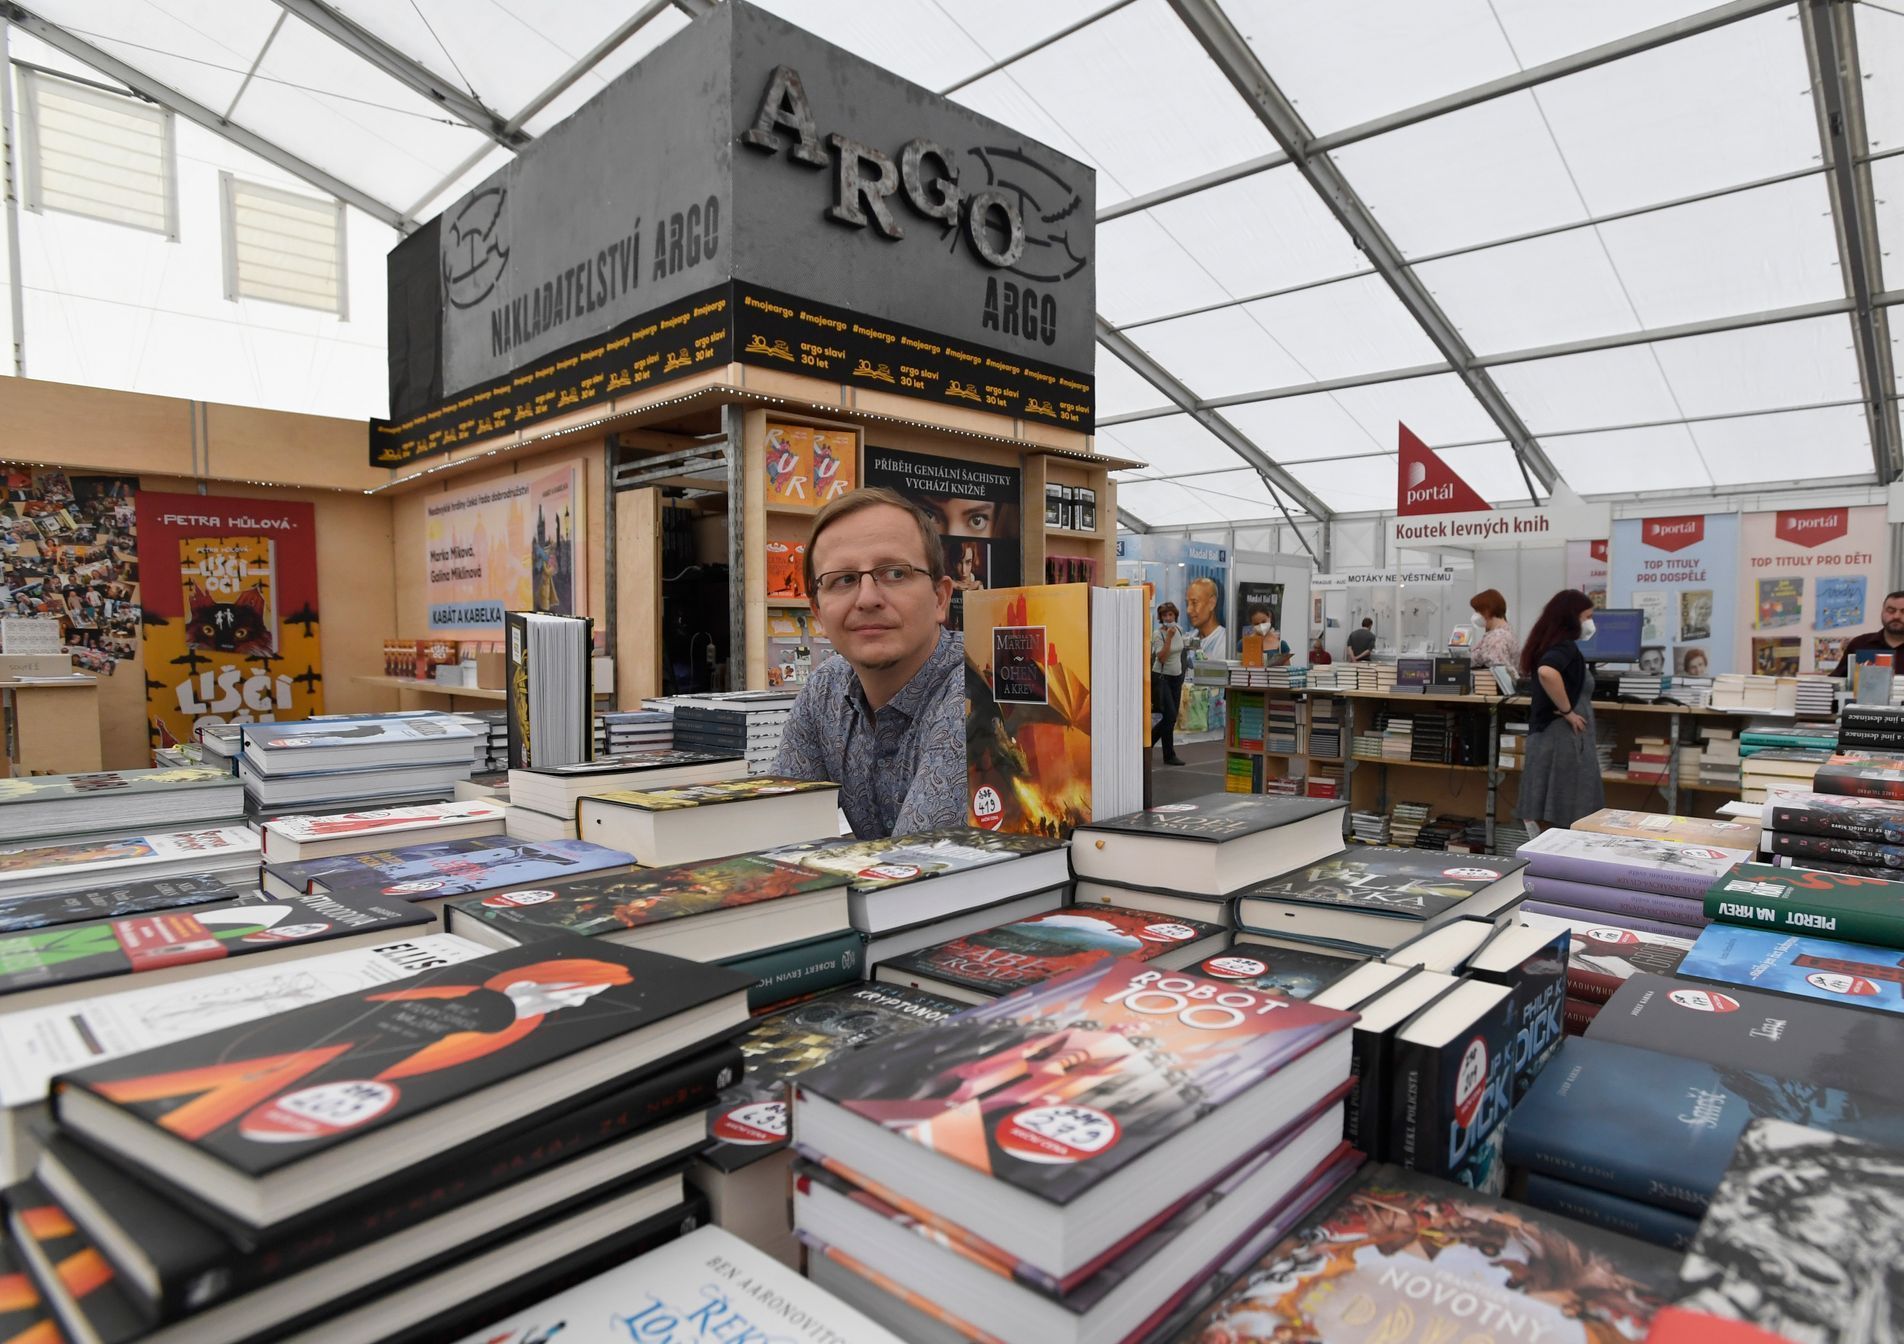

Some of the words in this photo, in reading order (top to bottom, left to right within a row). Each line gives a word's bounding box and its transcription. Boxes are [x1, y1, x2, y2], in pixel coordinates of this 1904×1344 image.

[741, 63, 1026, 269] ARGO
[490, 216, 642, 357] NAKLADATELSTVÍ
[652, 194, 721, 283] ARGO
[980, 276, 1058, 346] ARGO
[744, 296, 794, 318] #mojeargo
[799, 311, 848, 331] #mojeargo
[852, 324, 896, 343] #mojeargo
[901, 336, 941, 354] #mojeargo
[945, 347, 982, 366] #mojeargo
[800, 341, 822, 355] argo
[801, 354, 815, 365] 30
[816, 358, 829, 369] let
[900, 365, 919, 377] argo
[900, 376, 912, 387] 30
[914, 380, 924, 390] let
[985, 385, 1001, 395] argo
[985, 395, 996, 405] 30
[997, 398, 1007, 407] let
[874, 457, 912, 475] PŘÍBĚH
[914, 463, 961, 480] GENIÁLNÍ
[962, 468, 1012, 487] ŠACHISTKY
[905, 475, 950, 493] VYCHÁZÍ
[950, 481, 987, 498] KNIŽNĚ
[1406, 483, 1454, 505] portál
[164, 514, 221, 527] PETRA
[228, 515, 291, 530] HŮLOVÁ
[1396, 522, 1447, 540] Koutek
[1451, 518, 1509, 539] levných
[1514, 515, 1550, 533] knih
[1660, 521, 1696, 538] portál
[1797, 514, 1838, 531] portál
[1190, 548, 1209, 560] Madal
[1751, 557, 1773, 568] TOP
[1776, 556, 1813, 567] TITULY
[1816, 554, 1841, 566] PRO
[1845, 552, 1873, 565] DĚTI
[199, 553, 249, 577] LIŠČÍ
[431, 571, 450, 583] Galina
[450, 564, 482, 581] Miklínová
[1644, 560, 1663, 570] TOP
[1665, 558, 1700, 569] TITULY
[205, 574, 241, 593] OČI
[1348, 573, 1384, 583] MOTÁKY
[1385, 571, 1452, 583] NEVĚSTNÉMU
[1637, 572, 1658, 583] PRO
[1659, 570, 1707, 582] DOSPĚLÉ
[432, 606, 457, 625] KABÁT
[457, 611, 463, 622] A
[463, 607, 502, 622] KABELKA
[996, 634, 1040, 651] MARTIN
[1000, 663, 1038, 682] OHEŇ
[175, 664, 294, 715] LIŠČÍ
[1003, 684, 1011, 695] A
[1011, 684, 1034, 695] KREV
[1847, 713, 1883, 722] destinace
[1884, 714, 1899, 724] jiné
[1845, 730, 1880, 741] destinace
[1880, 732, 1896, 743] jiné
[977, 798, 996, 815] 419
[1719, 902, 1754, 920] KREV
[1756, 907, 1776, 922] NA
[1785, 911, 1836, 931] PIEROT
[373, 943, 447, 972] ELLIS
[775, 968, 802, 984] ERVIN
[803, 959, 836, 977] ROBERT
[1130, 970, 1289, 1015] ROBOT
[1105, 981, 1246, 1030] 100
[1523, 991, 1555, 1024] PHILIP
[1515, 999, 1561, 1074] DICK
[1406, 1070, 1419, 1124] POLICISTA
[1448, 1064, 1510, 1170] DICK
[704, 1255, 740, 1280] BEN
